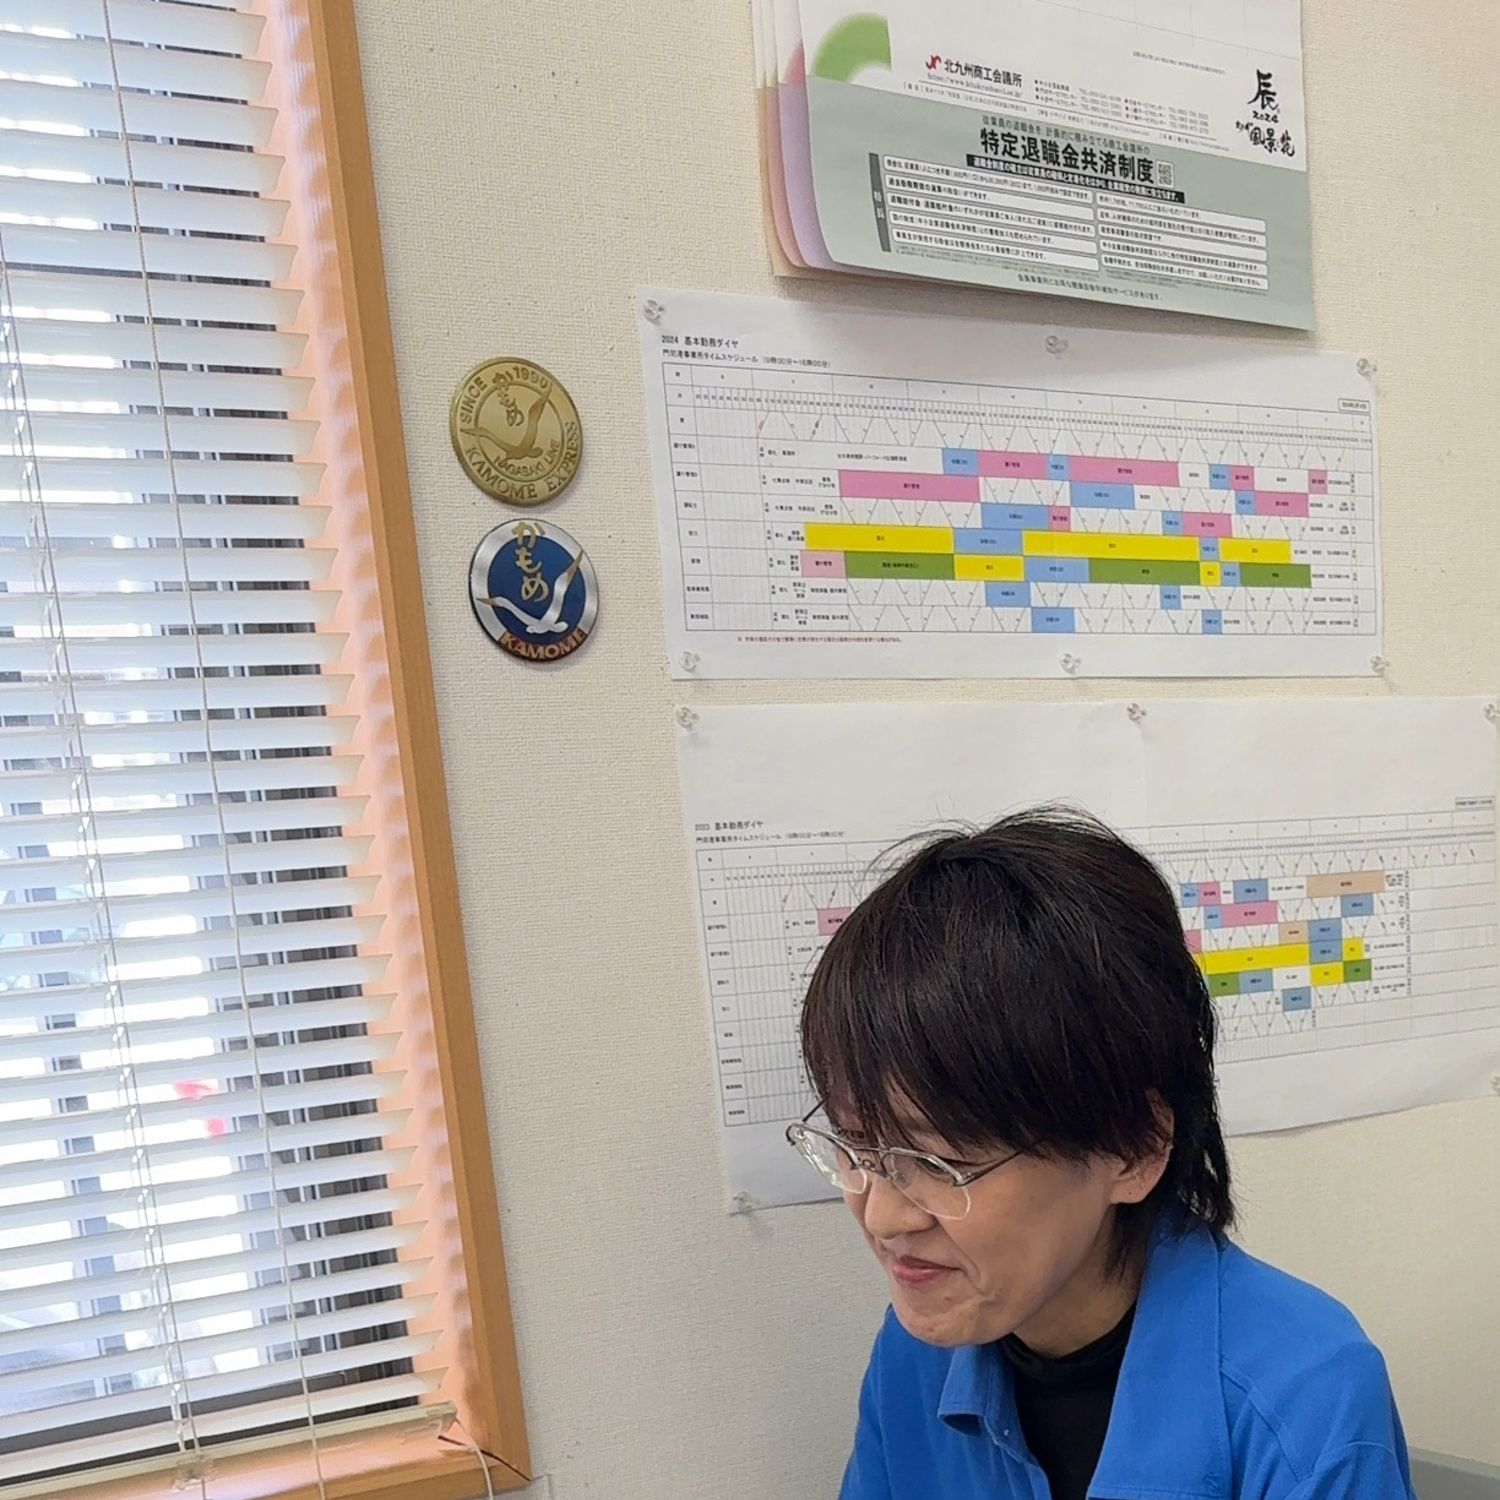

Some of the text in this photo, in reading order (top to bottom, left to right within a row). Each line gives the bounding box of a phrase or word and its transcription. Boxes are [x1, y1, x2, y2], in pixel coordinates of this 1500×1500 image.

[944, 59, 1022, 88] 北九州商工会議所
[1247, 69, 1280, 111] 辰
[1252, 111, 1279, 124] 2024
[980, 127, 1155, 184] 特定退職金共済制度
[684, 337, 739, 349] 基本勤務ダイヤ
[459, 375, 486, 424] SINCE
[466, 420, 578, 500] KAMOME EXPRESS
[512, 521, 550, 603] かもめ
[499, 628, 587, 661] KAMOME
